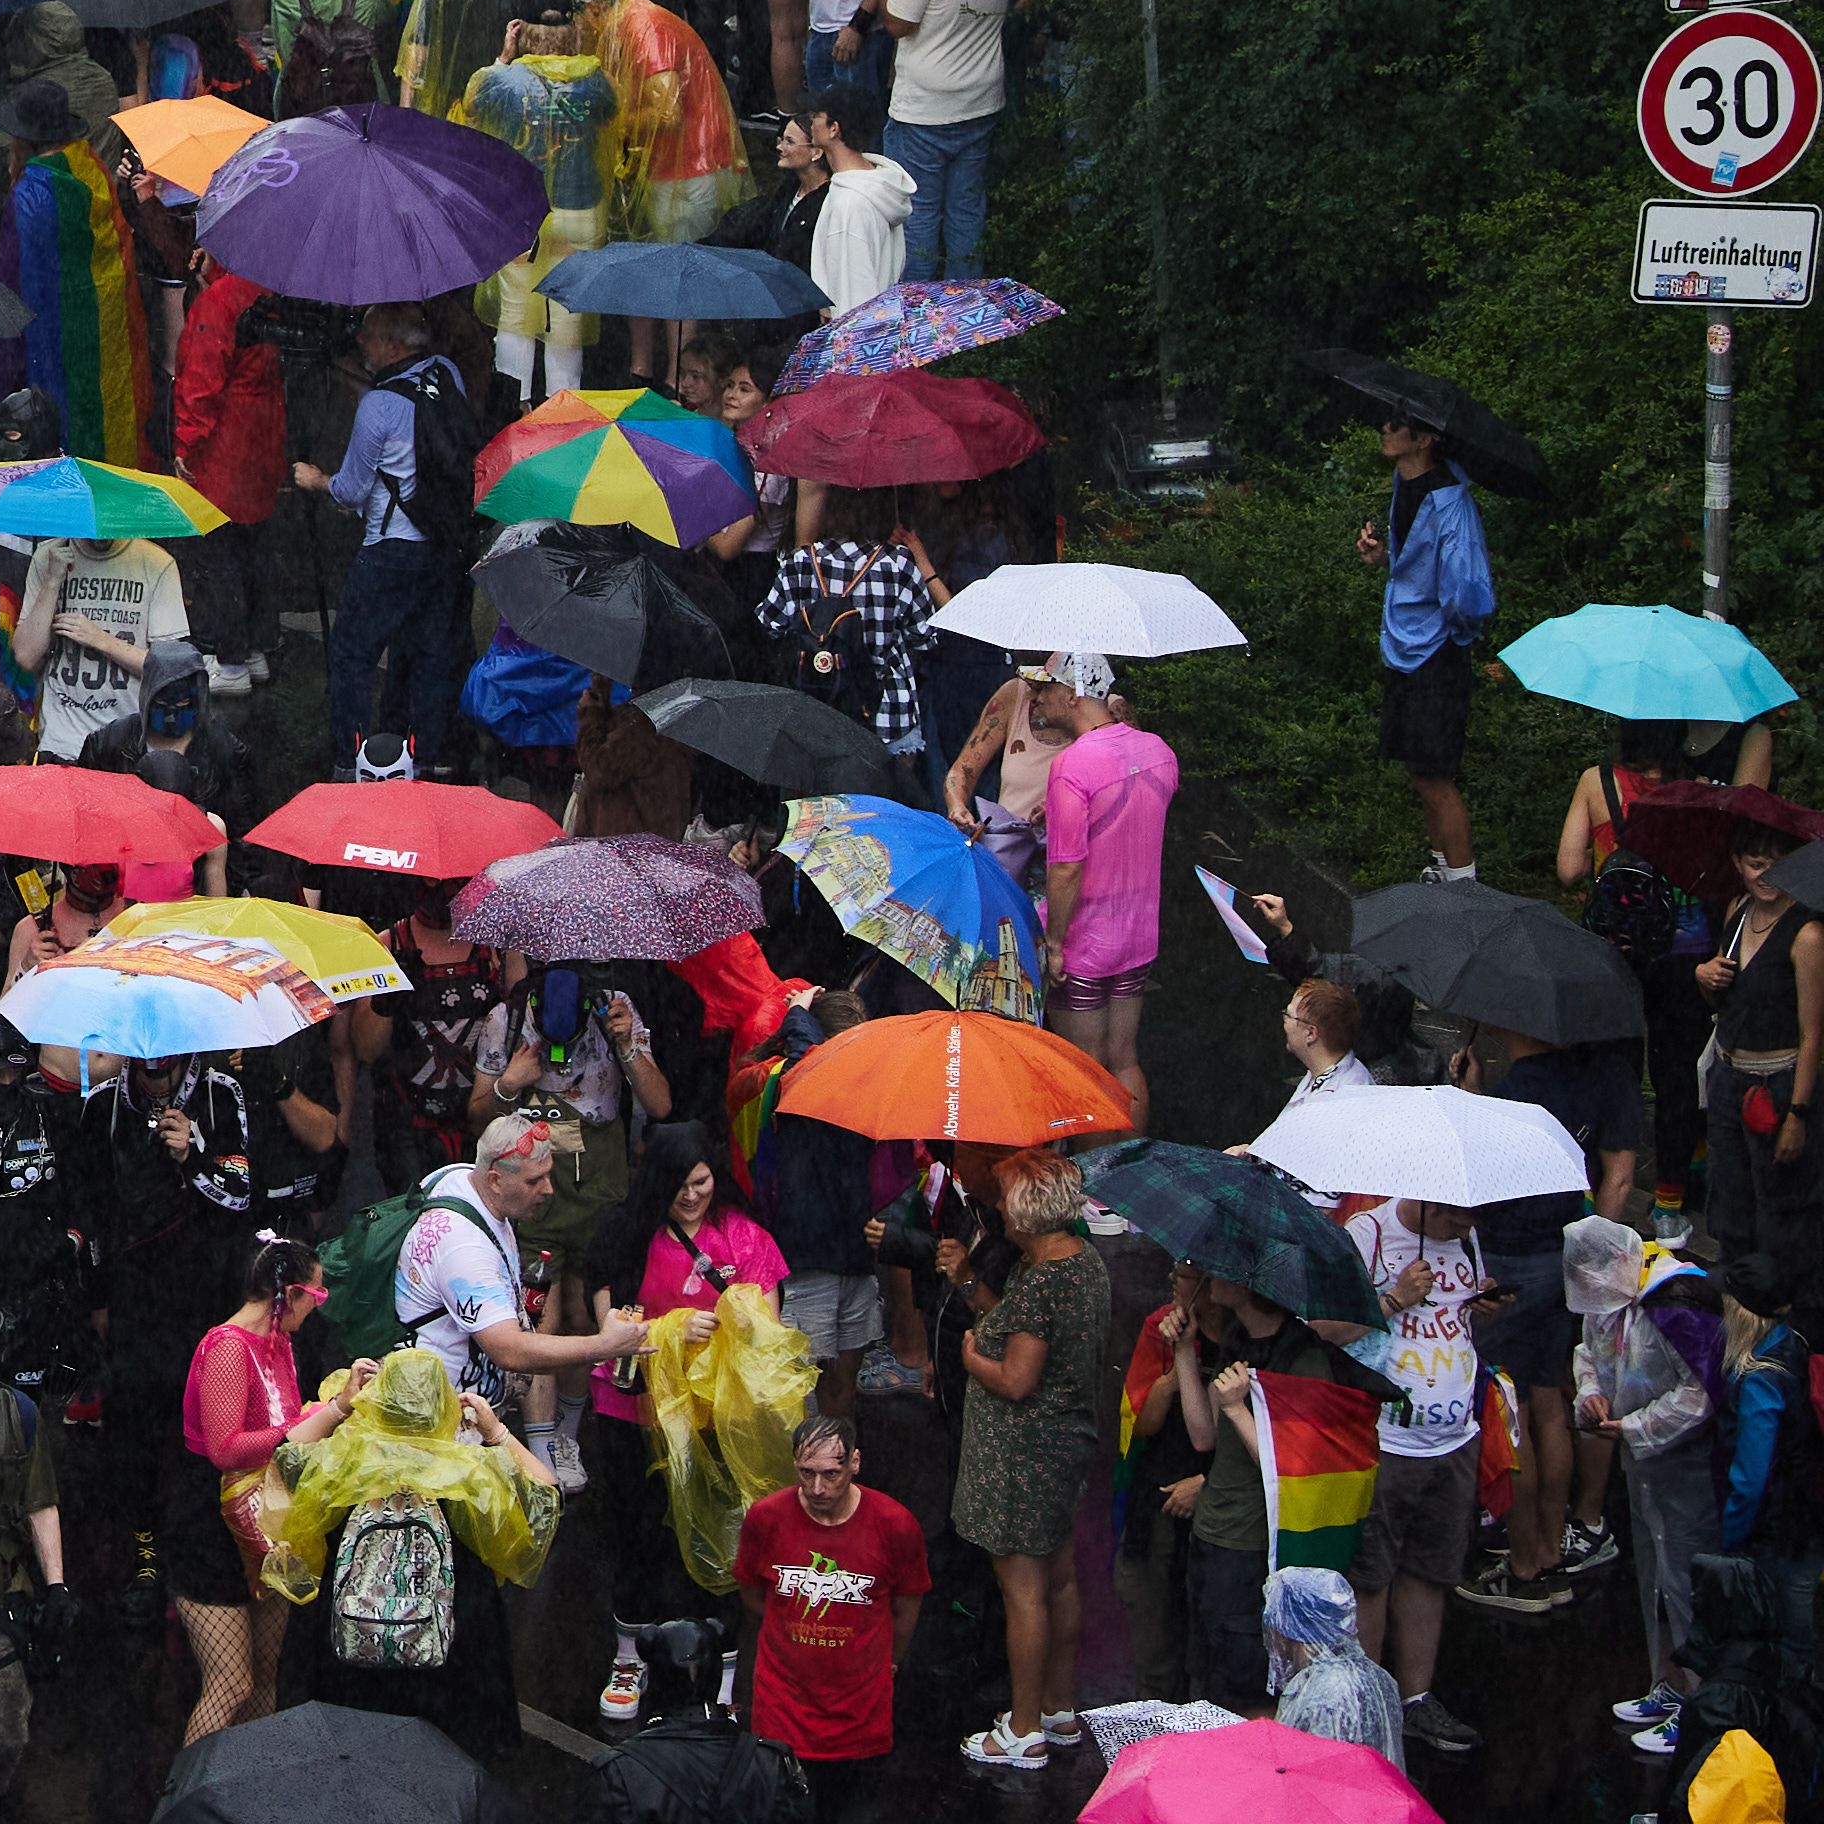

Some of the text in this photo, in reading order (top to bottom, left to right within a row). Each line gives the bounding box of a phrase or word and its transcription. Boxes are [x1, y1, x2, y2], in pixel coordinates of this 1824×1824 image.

[1680, 58, 1779, 148] 30
[1650, 237, 1803, 272] Luftreinhaltung
[111, 610, 140, 625] COAST
[945, 1056, 961, 1087] Kräfte.
[943, 1089, 959, 1139] Abwehr.
[792, 1634, 846, 1648] ENERGY
